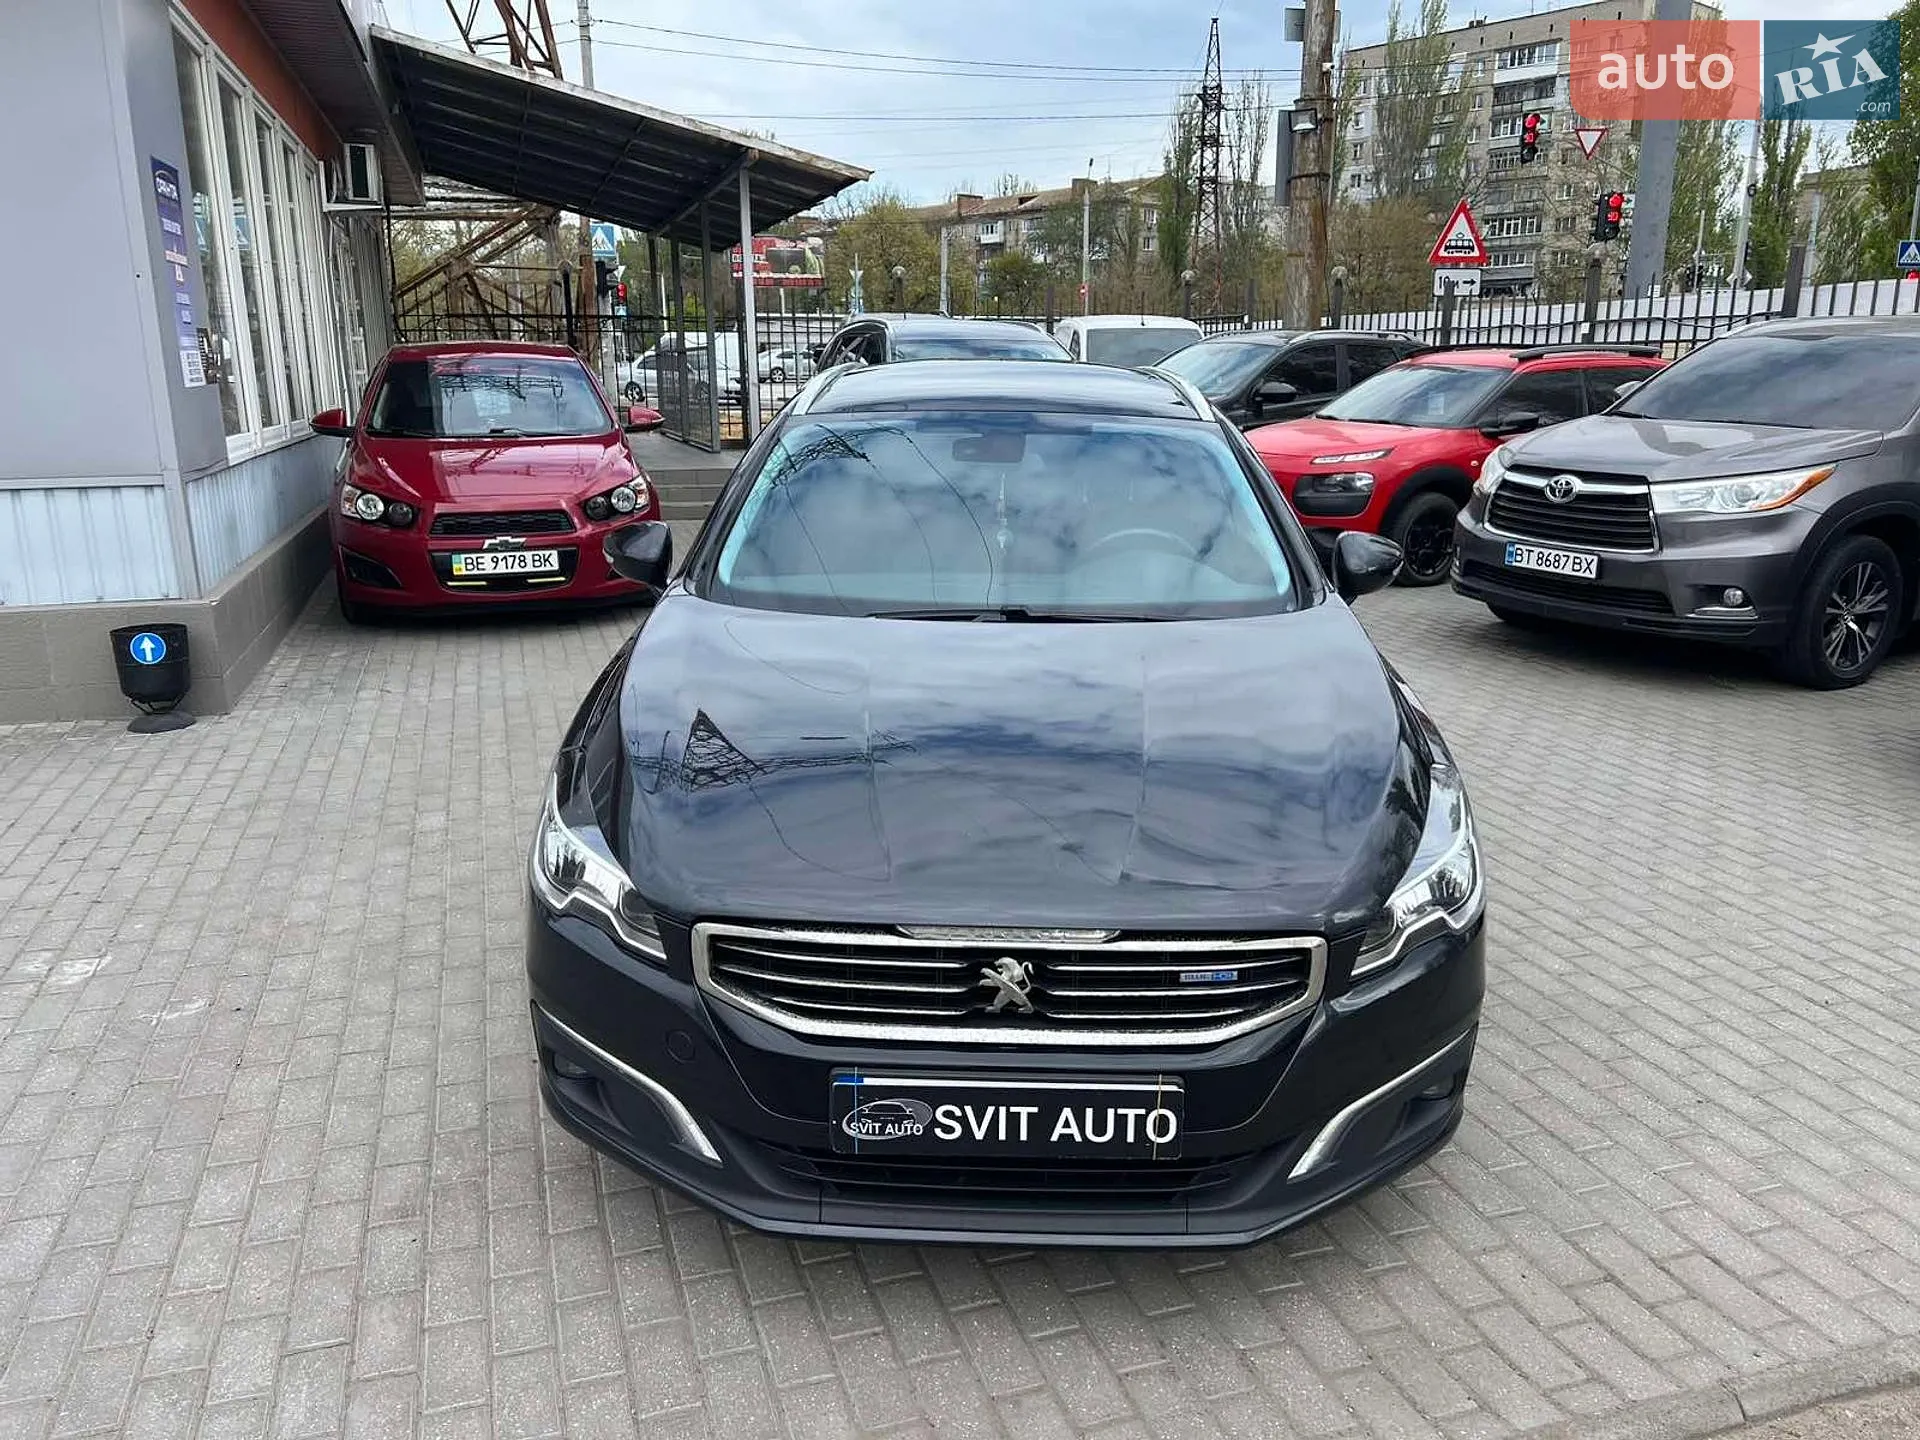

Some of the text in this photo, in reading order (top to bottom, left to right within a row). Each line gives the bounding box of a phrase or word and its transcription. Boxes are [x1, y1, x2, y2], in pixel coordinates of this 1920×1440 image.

[464, 553, 554, 572] BE 9178 BK
[1514, 547, 1594, 574] BT 8687 BX
[850, 1122, 923, 1136] SVIT AUTO
[934, 1105, 1178, 1144] SVIT AUTO
